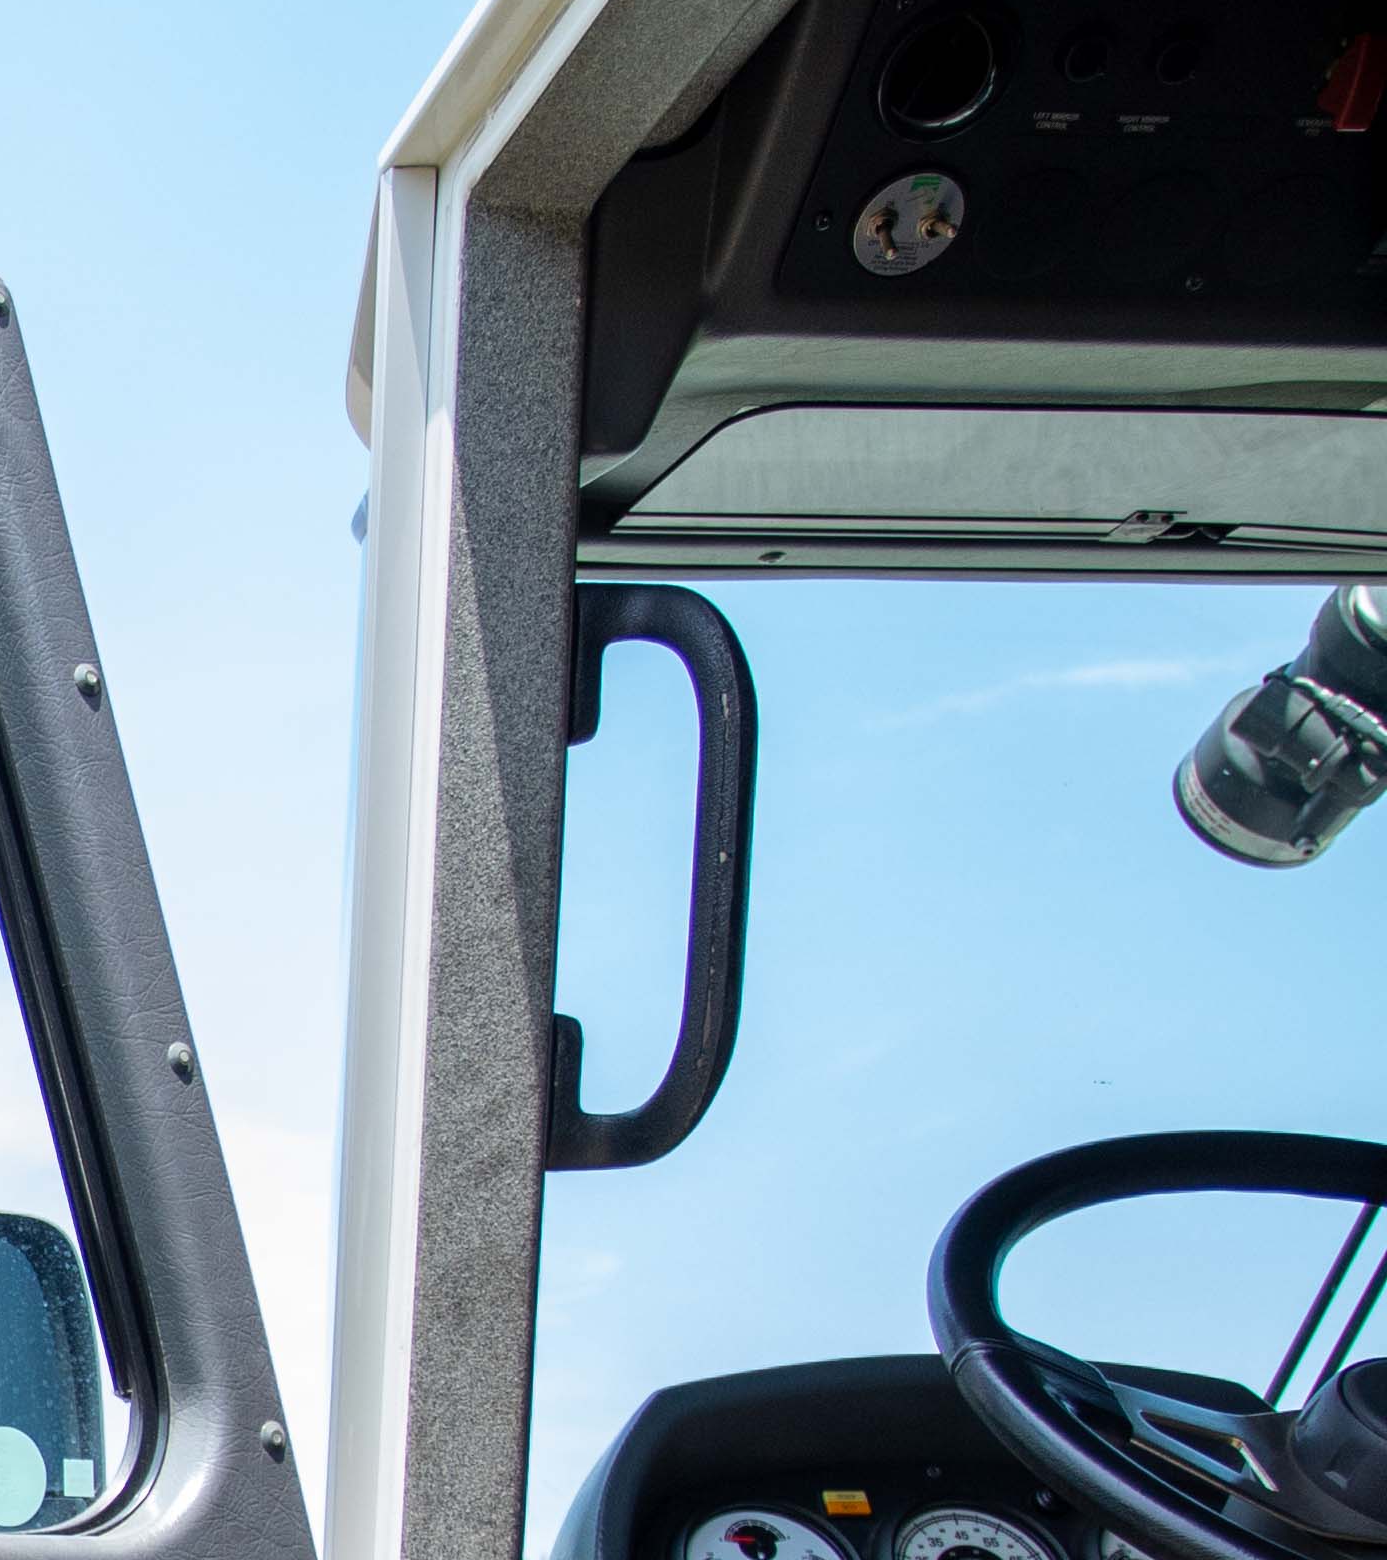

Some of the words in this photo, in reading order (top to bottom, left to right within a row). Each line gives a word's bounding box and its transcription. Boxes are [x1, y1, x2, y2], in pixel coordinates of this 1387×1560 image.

[954, 1530, 969, 1541] 45
[928, 1537, 944, 1548] 35
[983, 1537, 999, 1548] 55
